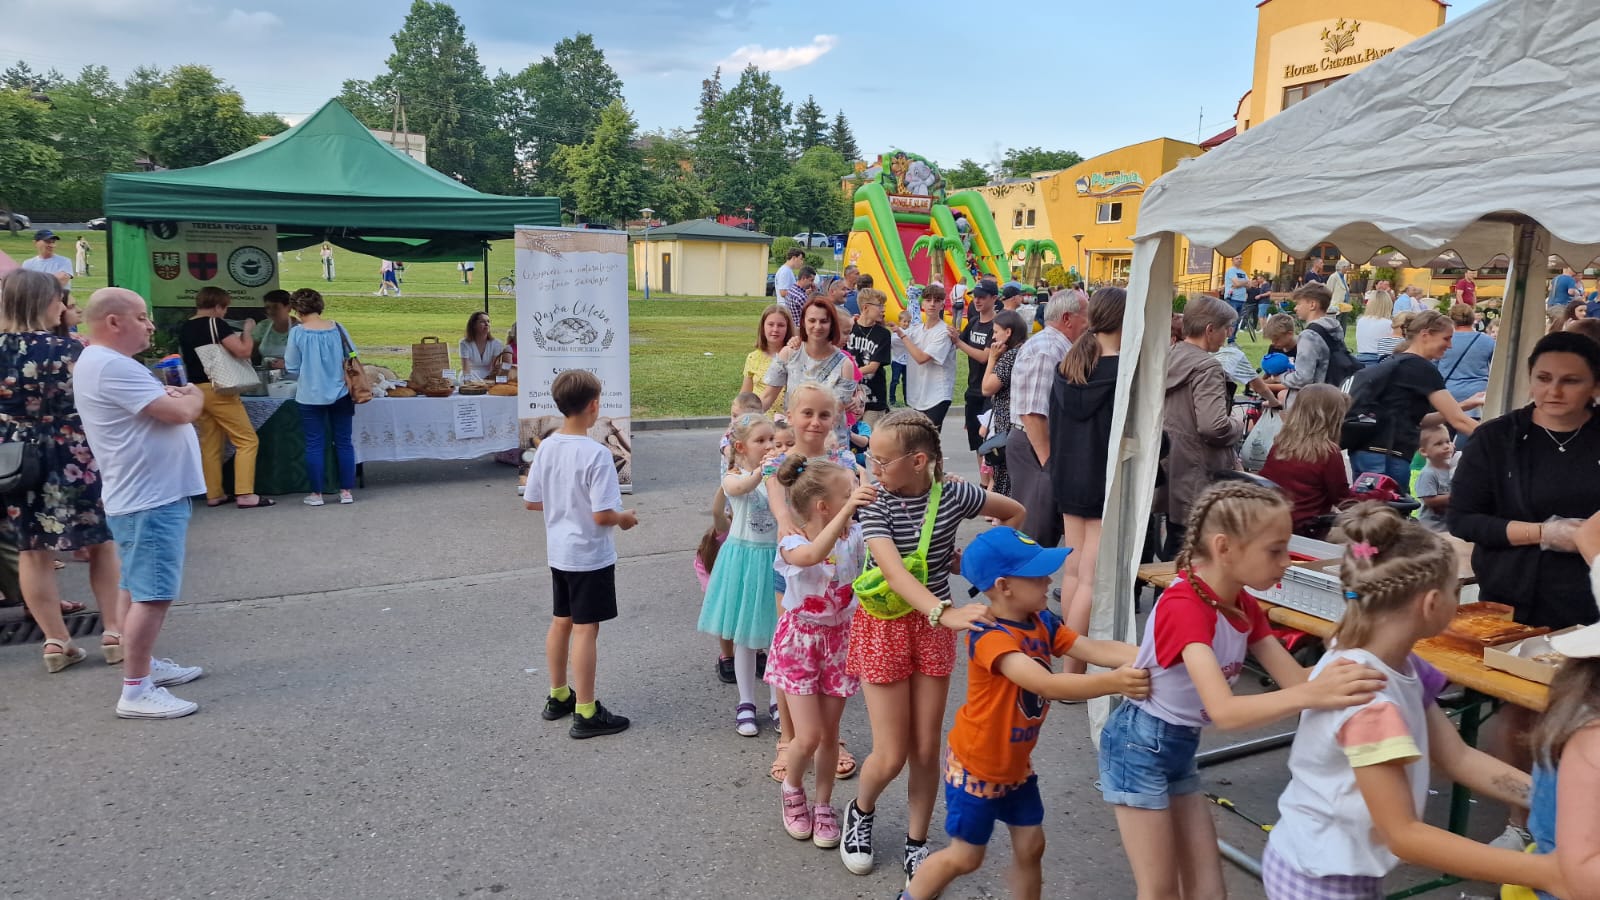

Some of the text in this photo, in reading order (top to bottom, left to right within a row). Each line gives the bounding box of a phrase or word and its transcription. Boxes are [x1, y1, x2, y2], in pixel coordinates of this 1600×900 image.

[192, 222, 222, 230] TERESA
[533, 299, 610, 326] Pajda Chleba
[970, 330, 987, 345] VANS
